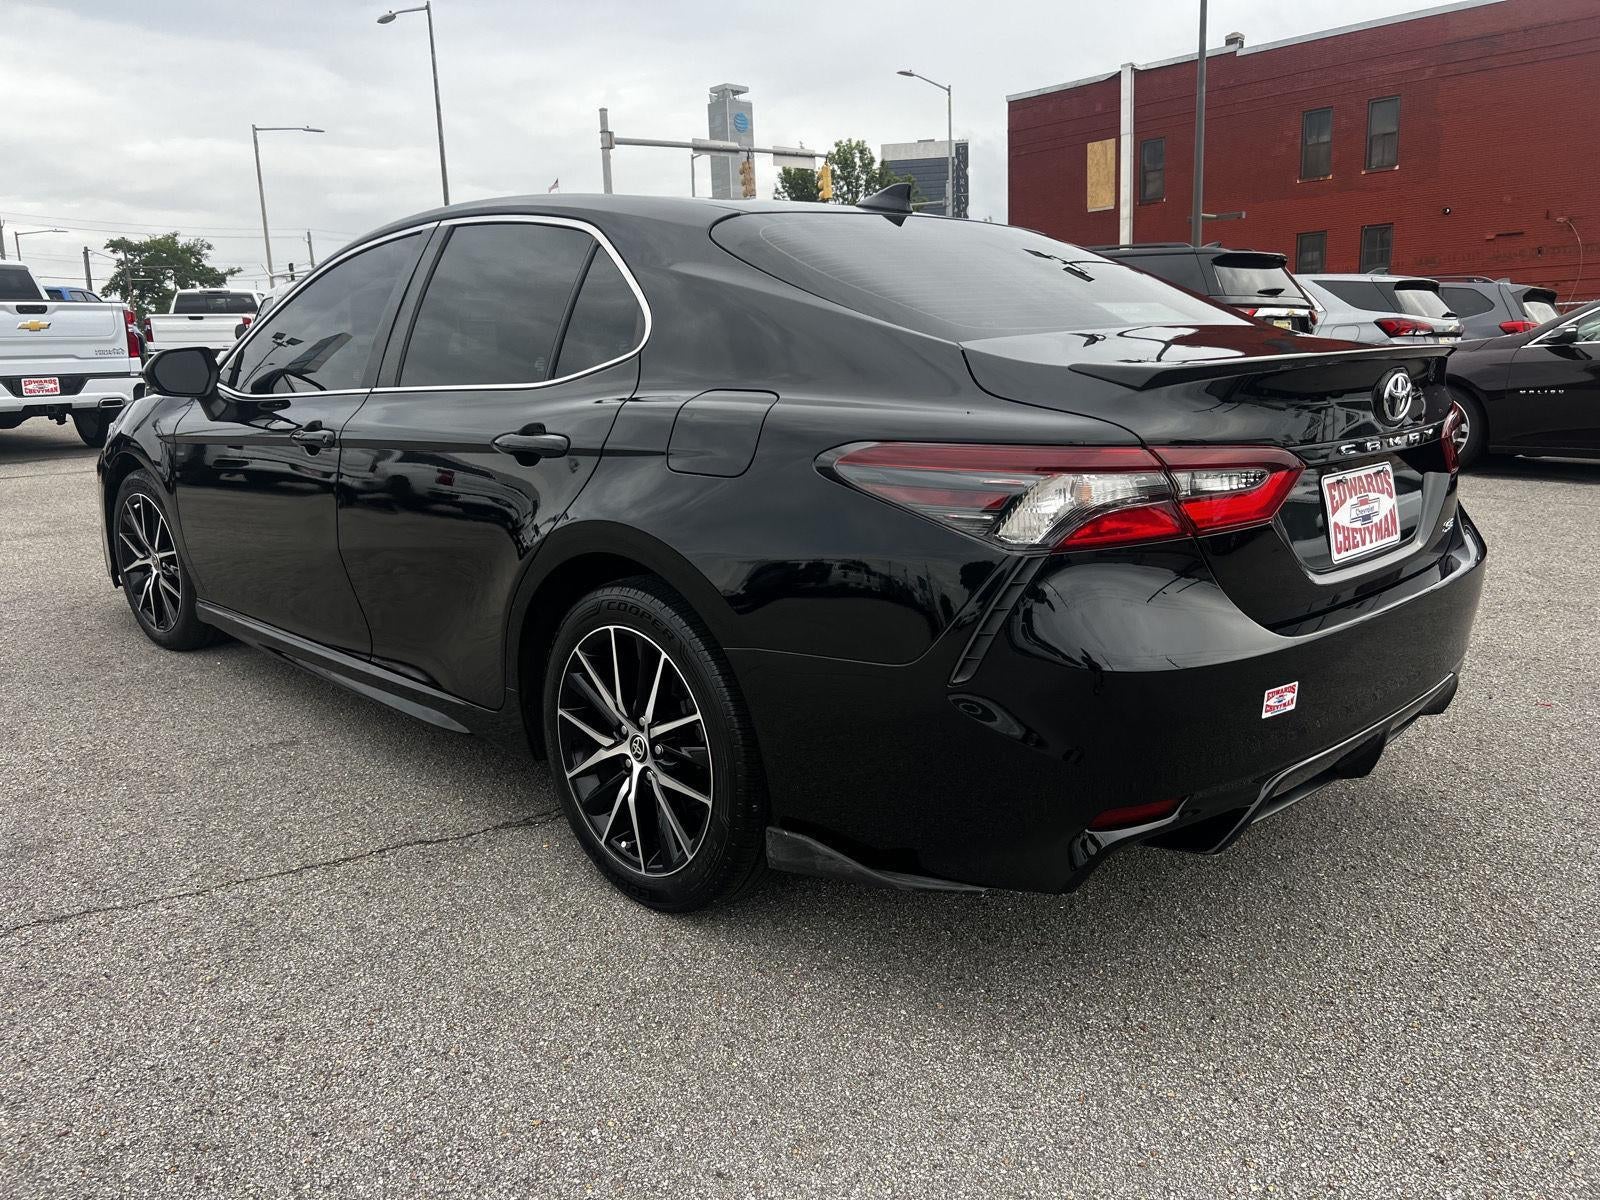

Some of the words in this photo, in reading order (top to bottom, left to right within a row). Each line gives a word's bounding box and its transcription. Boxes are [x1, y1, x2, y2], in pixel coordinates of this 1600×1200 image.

[23, 379, 58, 387] EDWARDS
[24, 386, 59, 394] CHEVYMAN
[1337, 428, 1434, 455] CAMRY
[1326, 469, 1394, 517] EDWARDS
[1333, 504, 1398, 555] CHEVYMAN
[606, 600, 673, 640] COOPER
[1264, 694, 1295, 713] CHEVYMAN
[1266, 683, 1297, 703] EDWARDS
